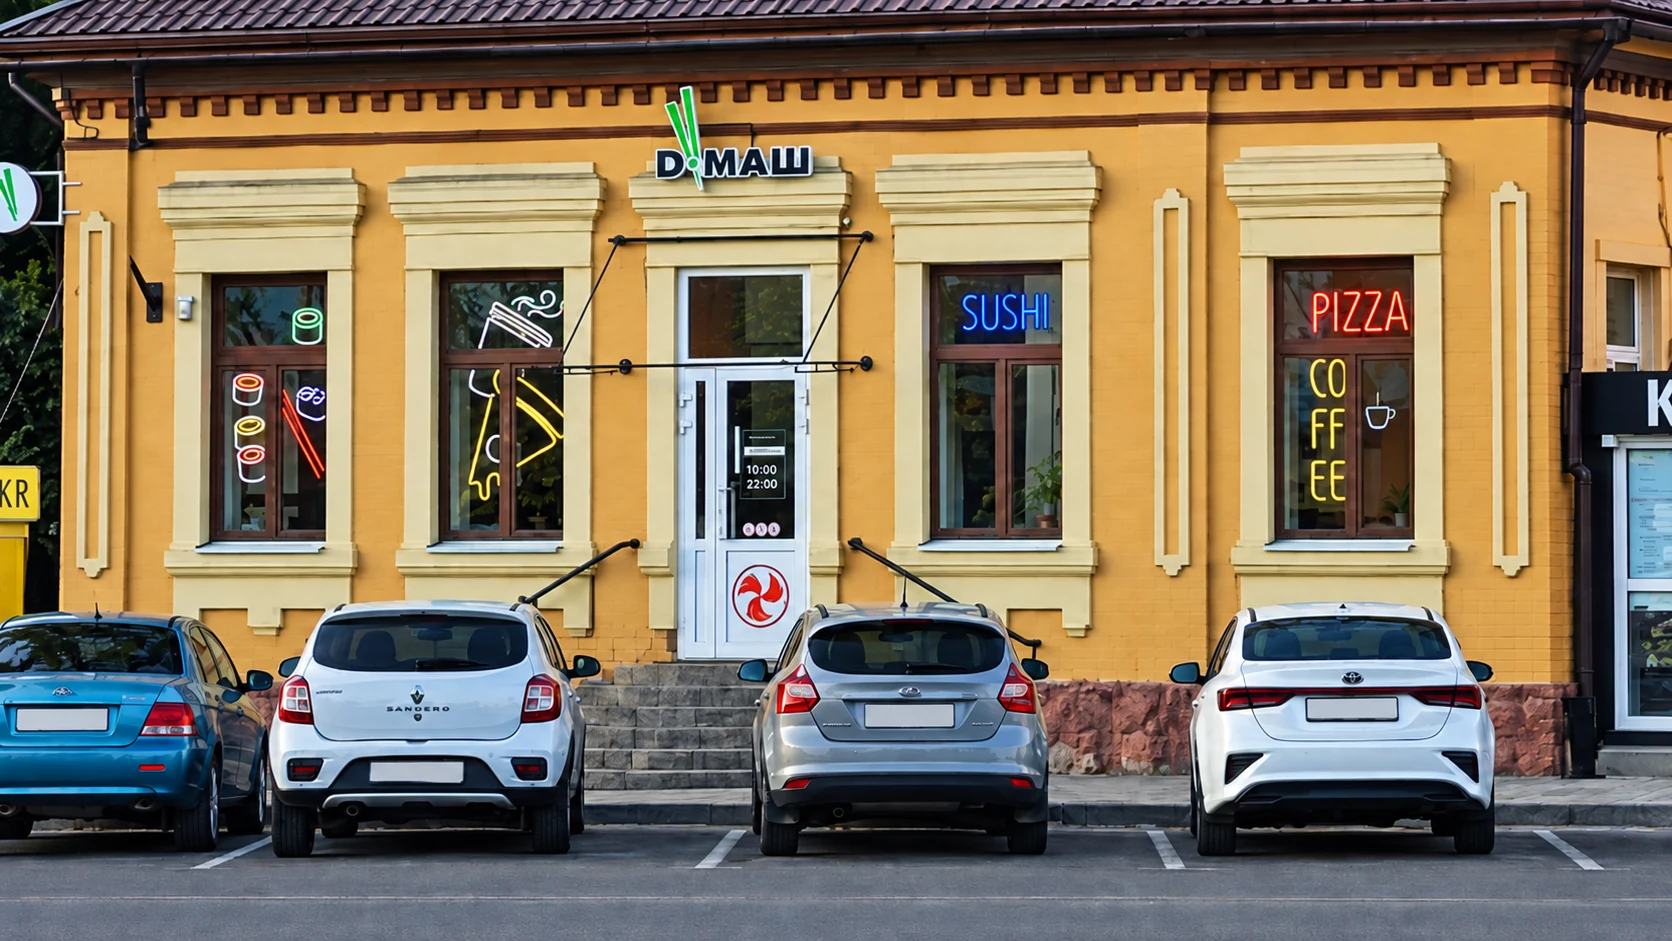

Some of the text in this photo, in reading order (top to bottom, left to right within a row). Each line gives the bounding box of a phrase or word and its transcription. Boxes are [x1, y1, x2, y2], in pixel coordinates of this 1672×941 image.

[961, 292, 1049, 331] SUSHI
[1311, 290, 1409, 334] PIZZA
[1309, 358, 1346, 398] CO
[1647, 379, 1672, 427] K
[1311, 408, 1346, 450] FF
[746, 464, 777, 475] 10:00
[746, 478, 778, 490] 22:00
[1310, 459, 1347, 502] EE
